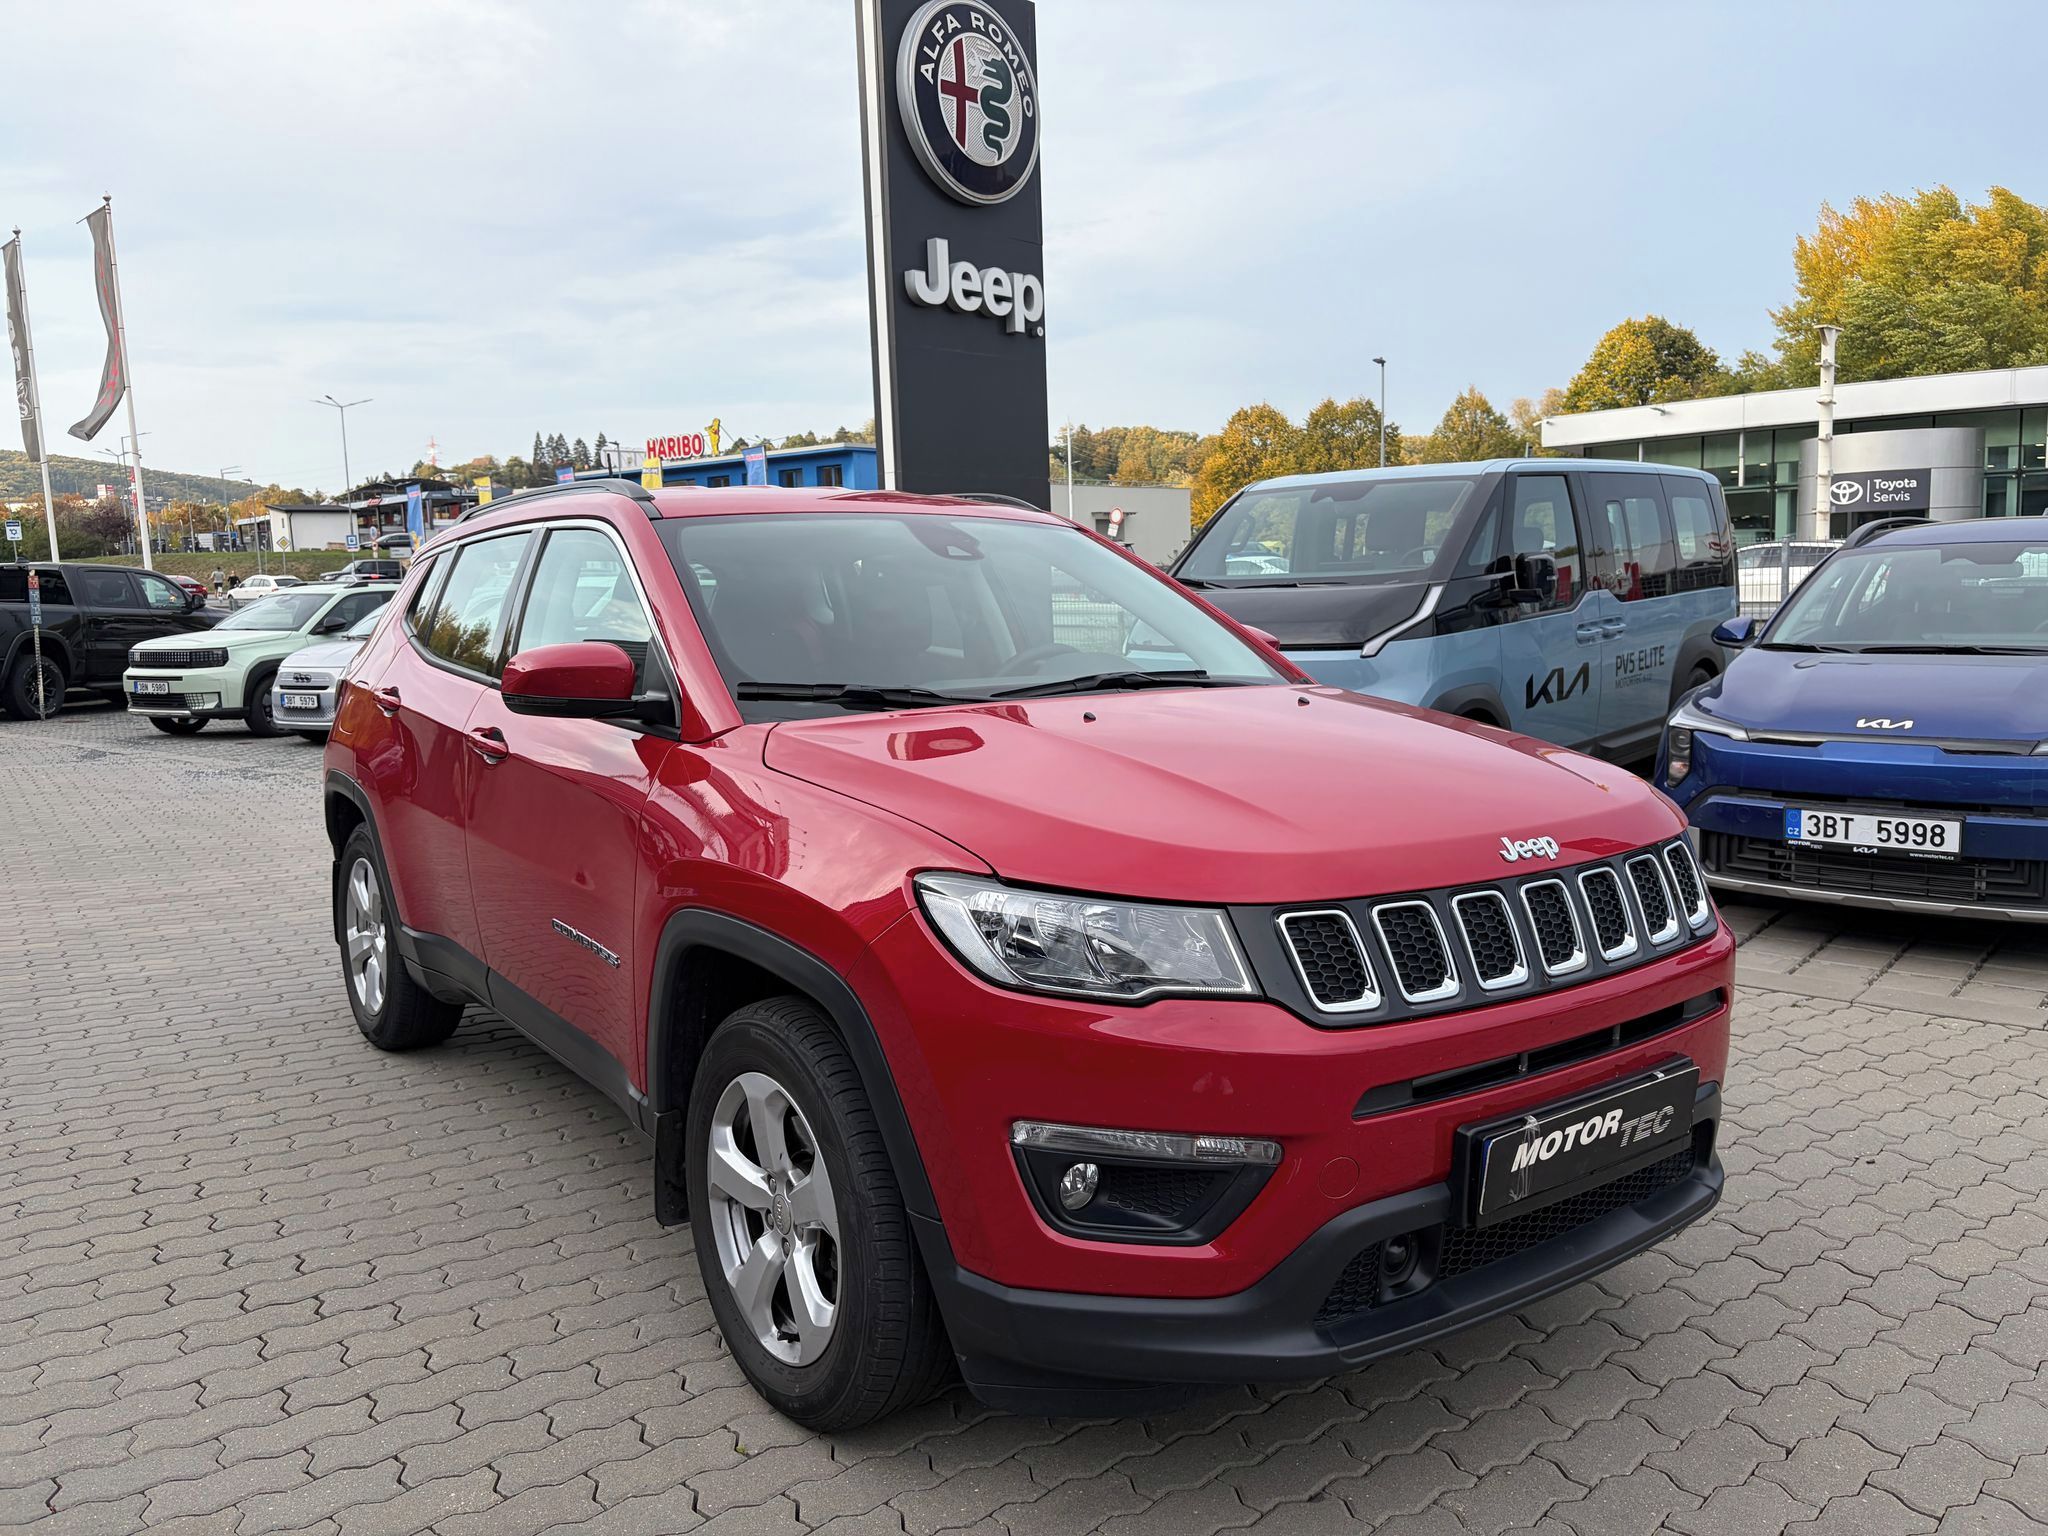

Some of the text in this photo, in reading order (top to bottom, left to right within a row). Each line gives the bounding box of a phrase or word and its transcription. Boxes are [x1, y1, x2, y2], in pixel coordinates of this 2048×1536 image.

[920, 11, 1033, 118] ALFA ROMEO
[904, 237, 1044, 333] Jeep
[645, 433, 703, 459] HARIBO
[1873, 478, 1917, 491] Toyota
[1873, 491, 1911, 503] Servis
[1615, 652, 1635, 678] PV5
[1638, 644, 1665, 672] ELITE
[1525, 662, 1590, 709] KIA
[1856, 718, 1914, 729] KIA
[1787, 814, 1946, 848] CZ 3BT 5998
[1499, 836, 1559, 862] Jeep
[1852, 846, 1878, 854] KIA
[551, 918, 621, 969] COMPASS
